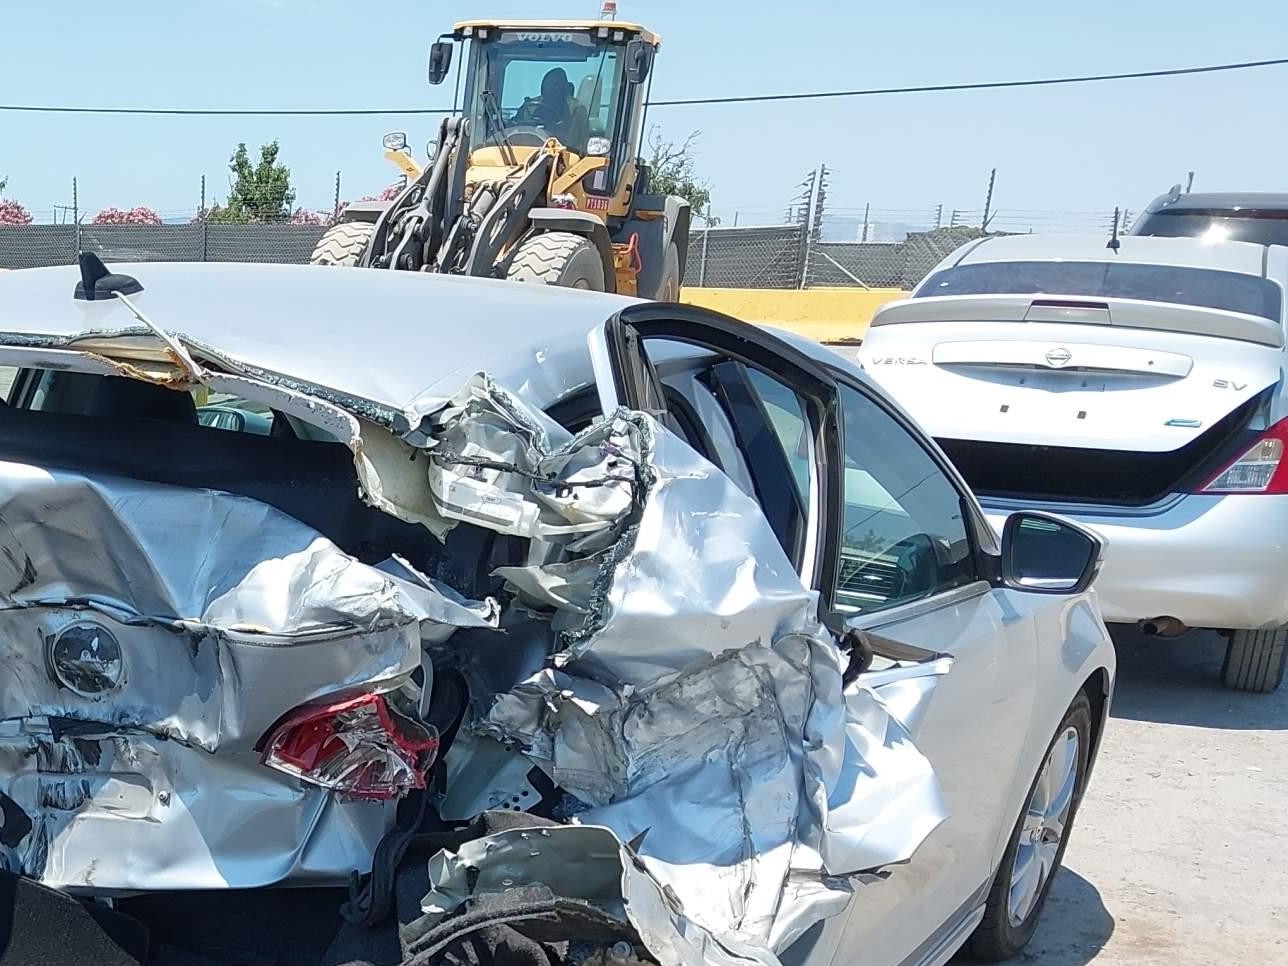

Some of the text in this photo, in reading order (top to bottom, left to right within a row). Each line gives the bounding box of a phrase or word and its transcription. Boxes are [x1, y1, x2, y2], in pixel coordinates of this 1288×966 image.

[516, 32, 573, 42] VOLVO
[872, 357, 928, 366] VERSA
[1212, 379, 1248, 391] SV
